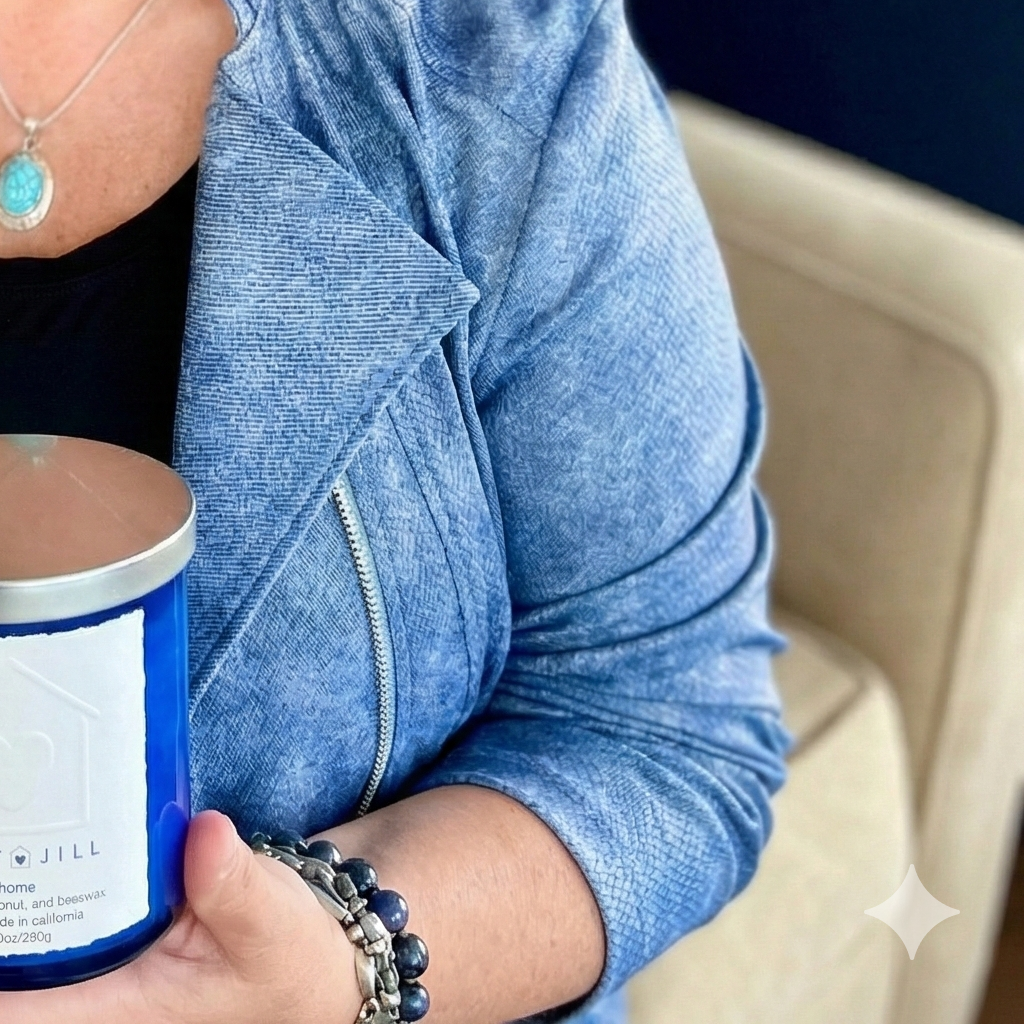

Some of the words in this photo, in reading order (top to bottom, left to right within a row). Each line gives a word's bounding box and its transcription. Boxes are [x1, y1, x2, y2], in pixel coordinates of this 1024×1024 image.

[40, 840, 100, 864] JILL
[32, 896, 54, 909] and
[57, 889, 106, 906] beeswax
[18, 915, 28, 927] in
